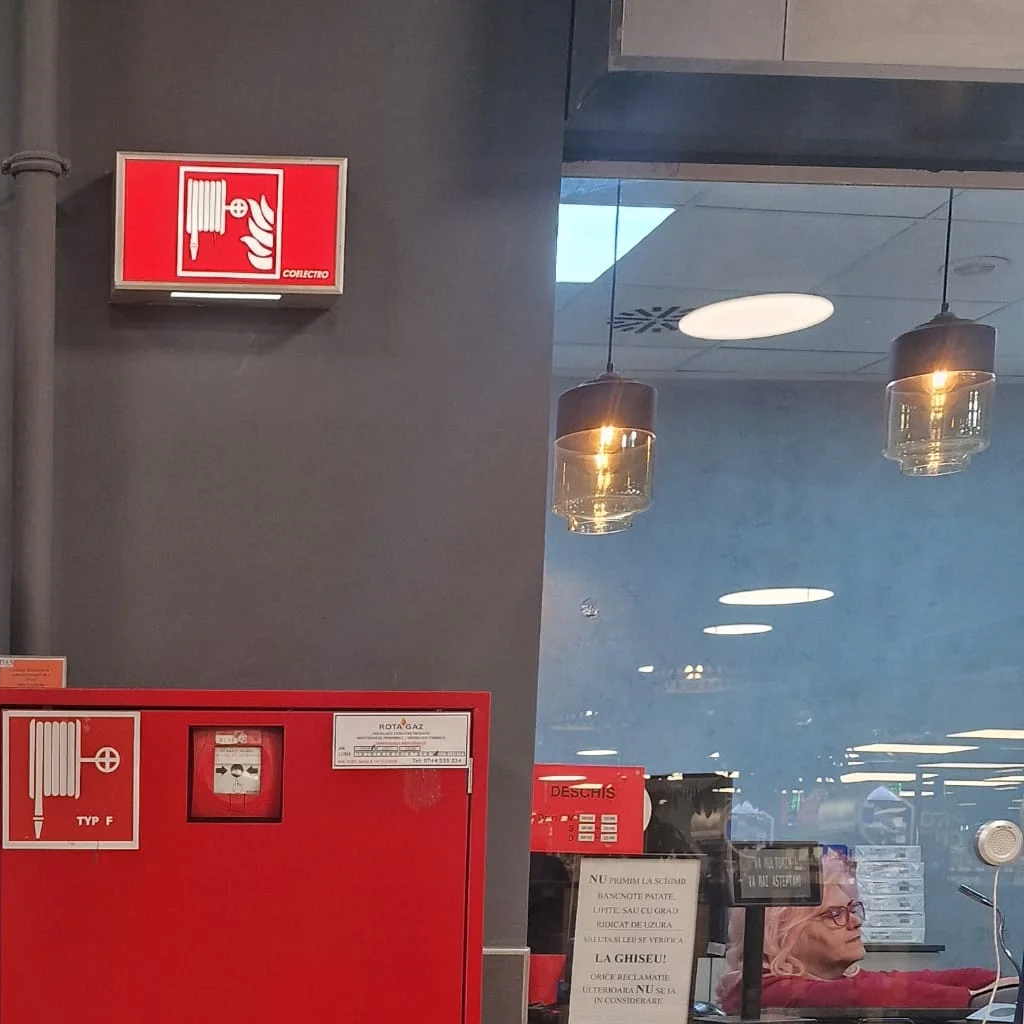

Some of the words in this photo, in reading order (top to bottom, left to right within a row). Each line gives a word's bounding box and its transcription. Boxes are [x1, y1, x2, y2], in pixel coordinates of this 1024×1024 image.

[282, 270, 329, 280] COELECTRO
[379, 723, 403, 731] ROTA
[405, 723, 424, 731] GAZ
[551, 785, 616, 800] DESCHIS
[76, 816, 100, 827] TYP
[106, 816, 114, 827] F
[589, 874, 607, 885] NU
[609, 877, 640, 885] PRIMIM
[622, 906, 639, 914] SAU
[654, 907, 679, 915] GRAD
[644, 921, 673, 929] UZURA
[595, 953, 611, 963] LA
[614, 953, 666, 964] GHISEU!
[590, 973, 616, 981] ORICE
[582, 986, 634, 994] ULTERIOARA
[636, 984, 654, 994] NU
[655, 987, 665, 995] SE
[604, 997, 665, 1005] CONSIDERARE
